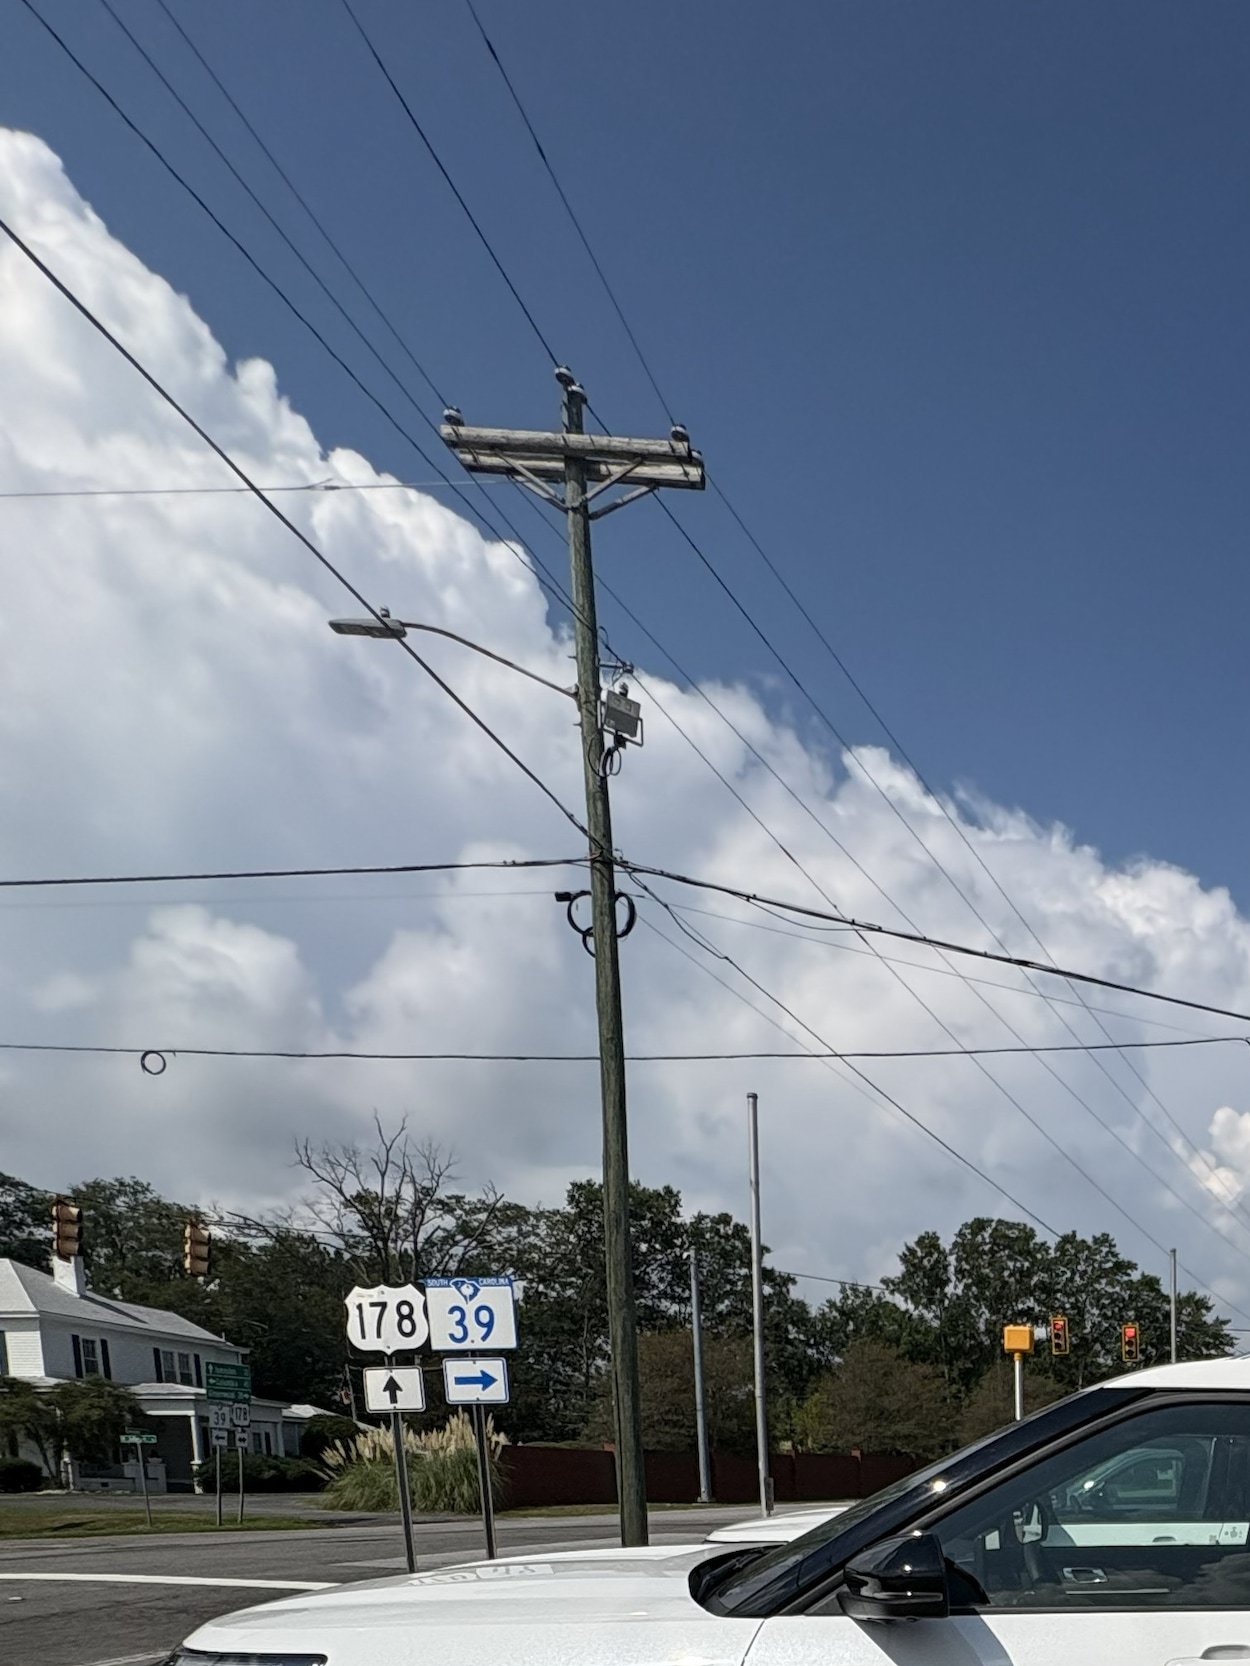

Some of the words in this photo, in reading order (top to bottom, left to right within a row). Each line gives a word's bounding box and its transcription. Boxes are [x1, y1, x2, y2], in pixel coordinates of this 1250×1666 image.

[427, 1279, 448, 1287] SOUTH
[479, 1278, 510, 1286] CAROLINA
[356, 1300, 416, 1340] 178
[448, 1305, 495, 1343] 39
[214, 1411, 226, 1425] 39
[236, 1407, 247, 1421] 178
